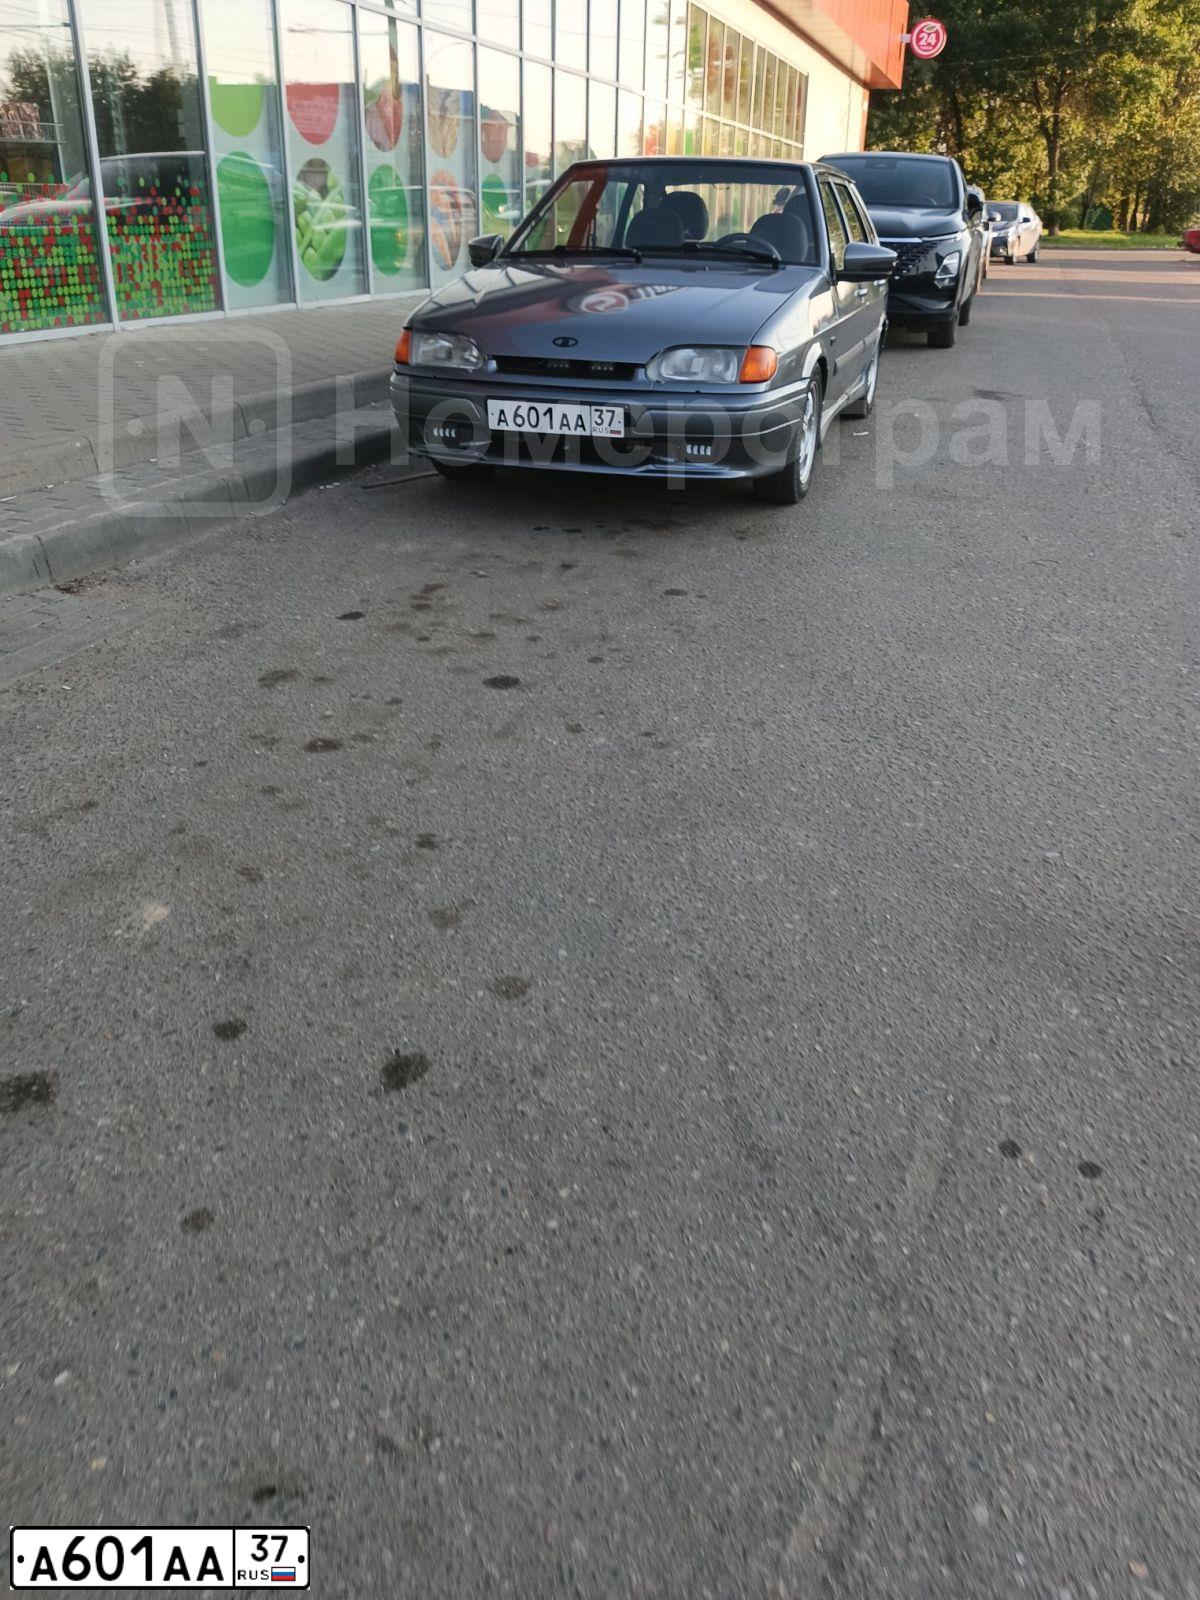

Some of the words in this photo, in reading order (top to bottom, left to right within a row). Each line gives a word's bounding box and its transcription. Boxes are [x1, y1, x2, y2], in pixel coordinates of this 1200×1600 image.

[918, 32, 937, 46] 24
[497, 405, 587, 432] А601АА
[594, 408, 616, 427] 37
[592, 426, 610, 434] RUS
